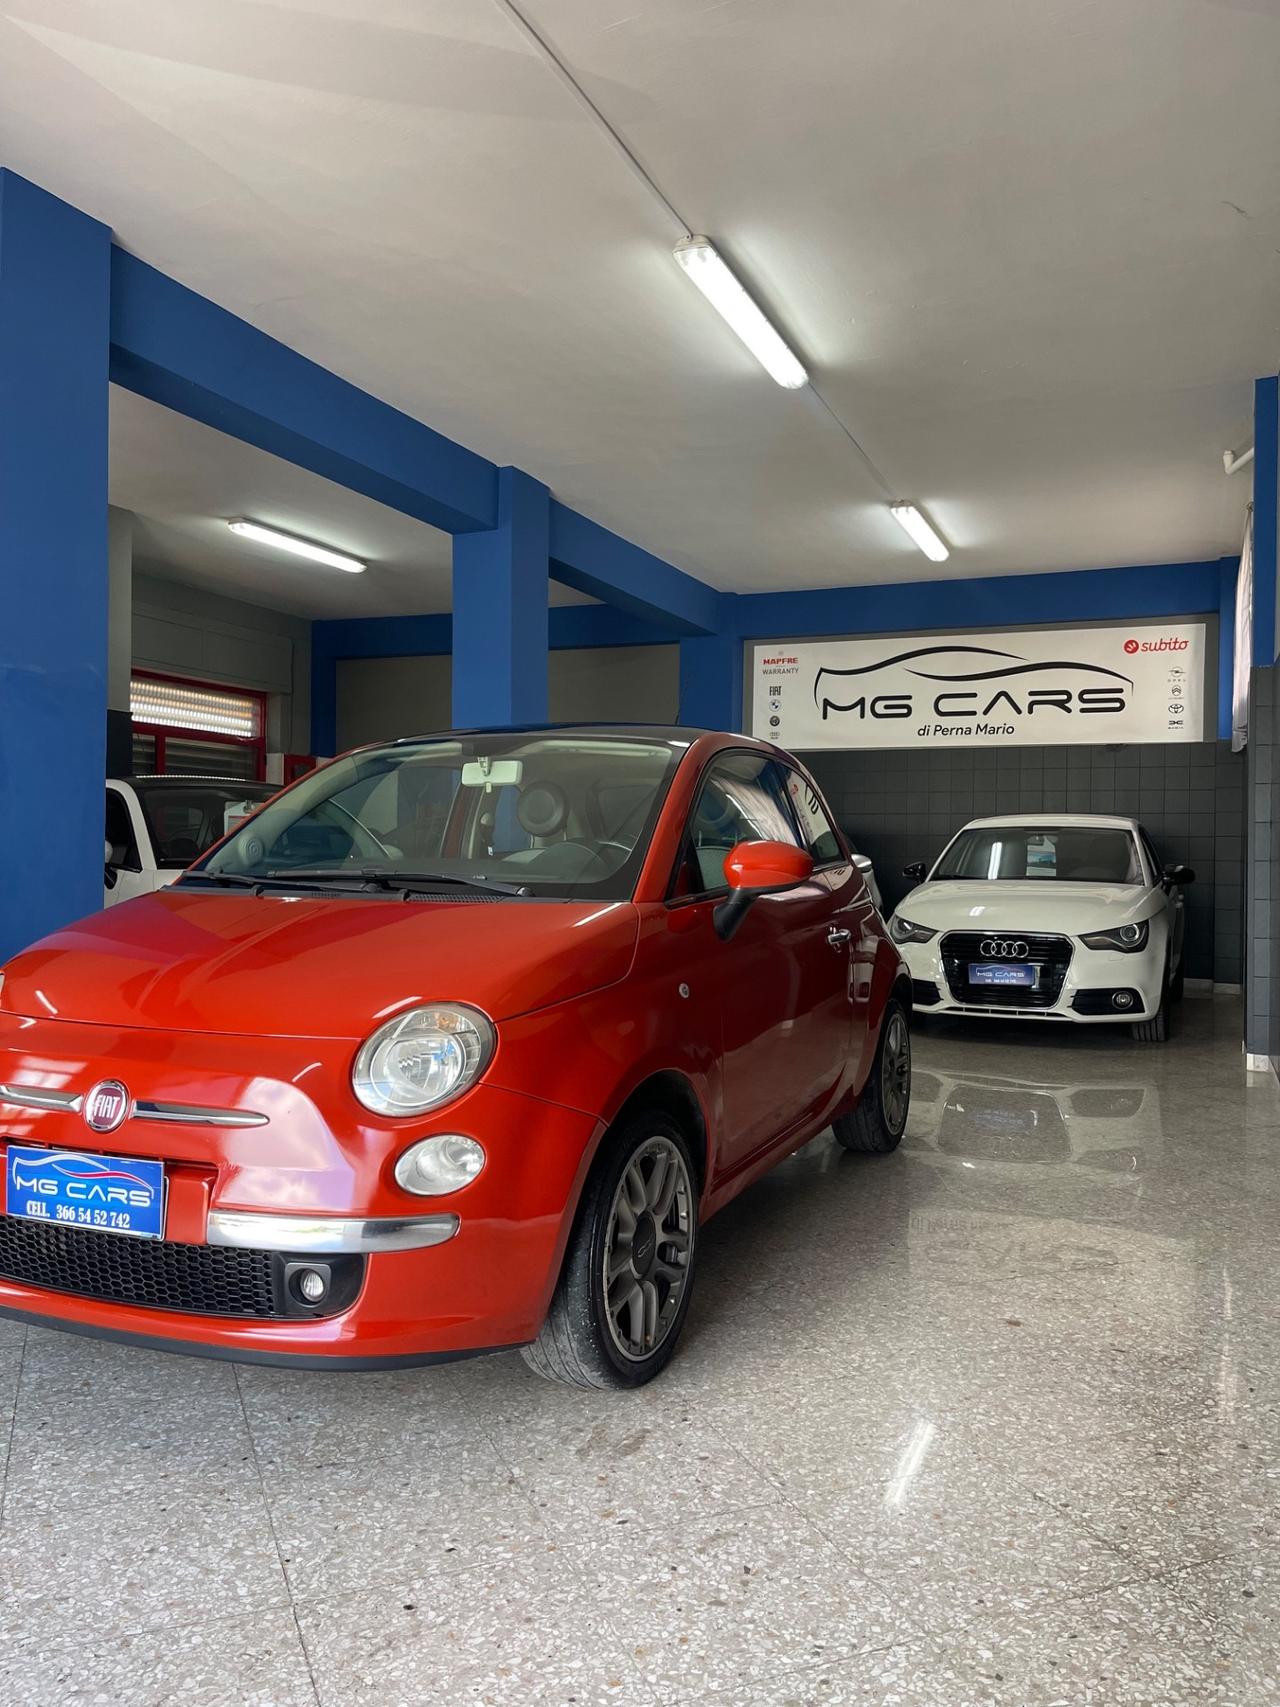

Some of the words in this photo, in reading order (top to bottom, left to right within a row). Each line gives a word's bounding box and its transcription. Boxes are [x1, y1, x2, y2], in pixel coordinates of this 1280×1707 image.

[1141, 638, 1189, 652] subito
[763, 657, 798, 665] MAPFRE
[769, 686, 781, 696] FIAT
[822, 694, 913, 720] MG
[933, 688, 1126, 717] CARS
[917, 725, 930, 736] di
[933, 724, 972, 736] Perna
[975, 723, 1015, 735] Mario
[94, 1094, 120, 1119] FIAT
[16, 1175, 59, 1195] MG
[66, 1183, 151, 1207] CARS
[26, 1200, 51, 1217] CELL.
[56, 1204, 76, 1221] 366
[78, 1208, 91, 1223] 54
[94, 1209, 107, 1225] 52
[110, 1212, 130, 1228] 742
